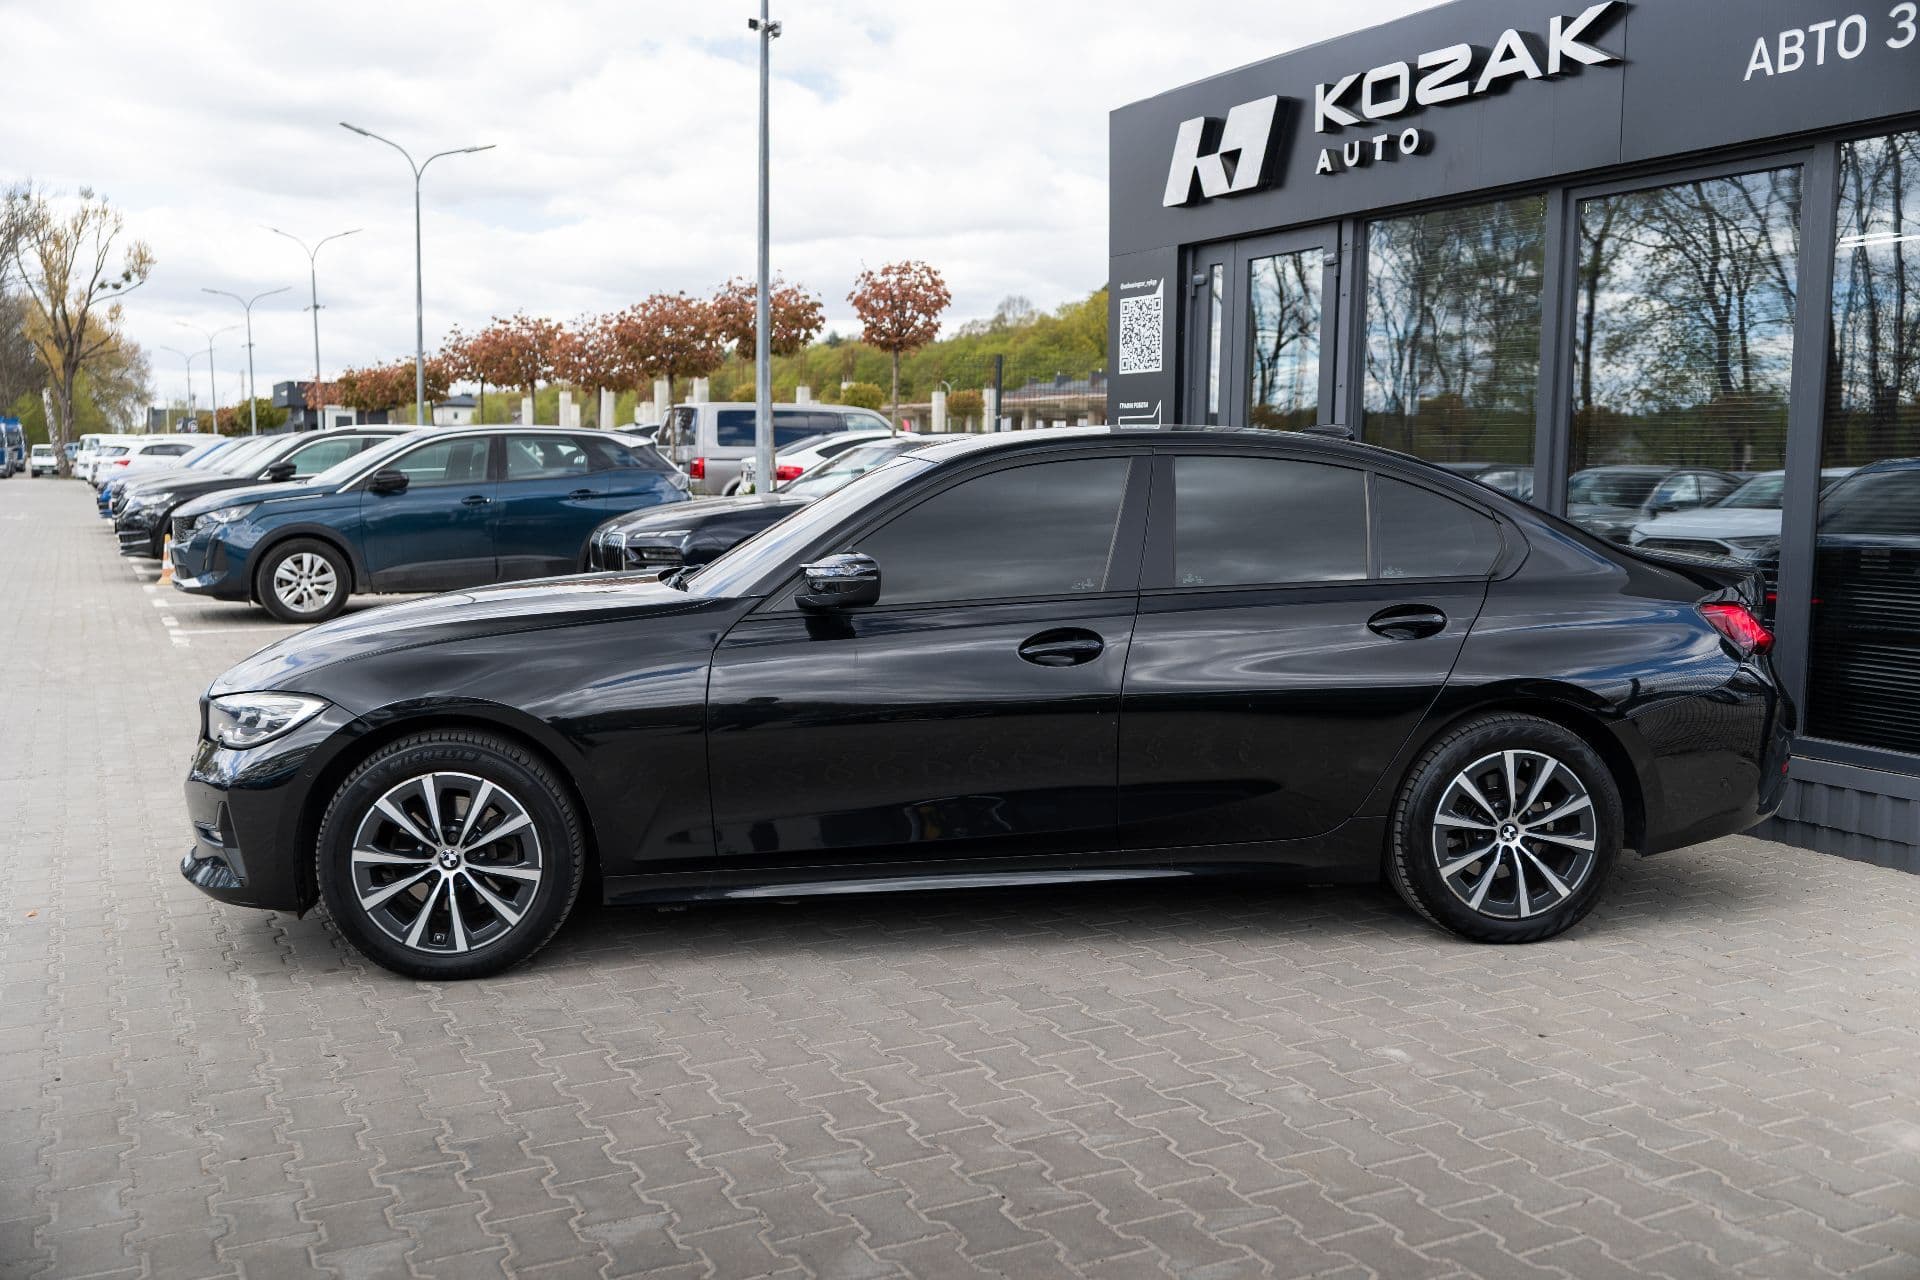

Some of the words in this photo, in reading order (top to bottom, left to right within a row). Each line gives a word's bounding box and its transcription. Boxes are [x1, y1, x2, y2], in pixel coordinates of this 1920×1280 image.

[1314, 1, 1620, 132] KOZAK
[1743, 14, 1867, 81] АВТО
[1315, 127, 1420, 175] AUTO
[389, 749, 476, 769] MICHELIN
